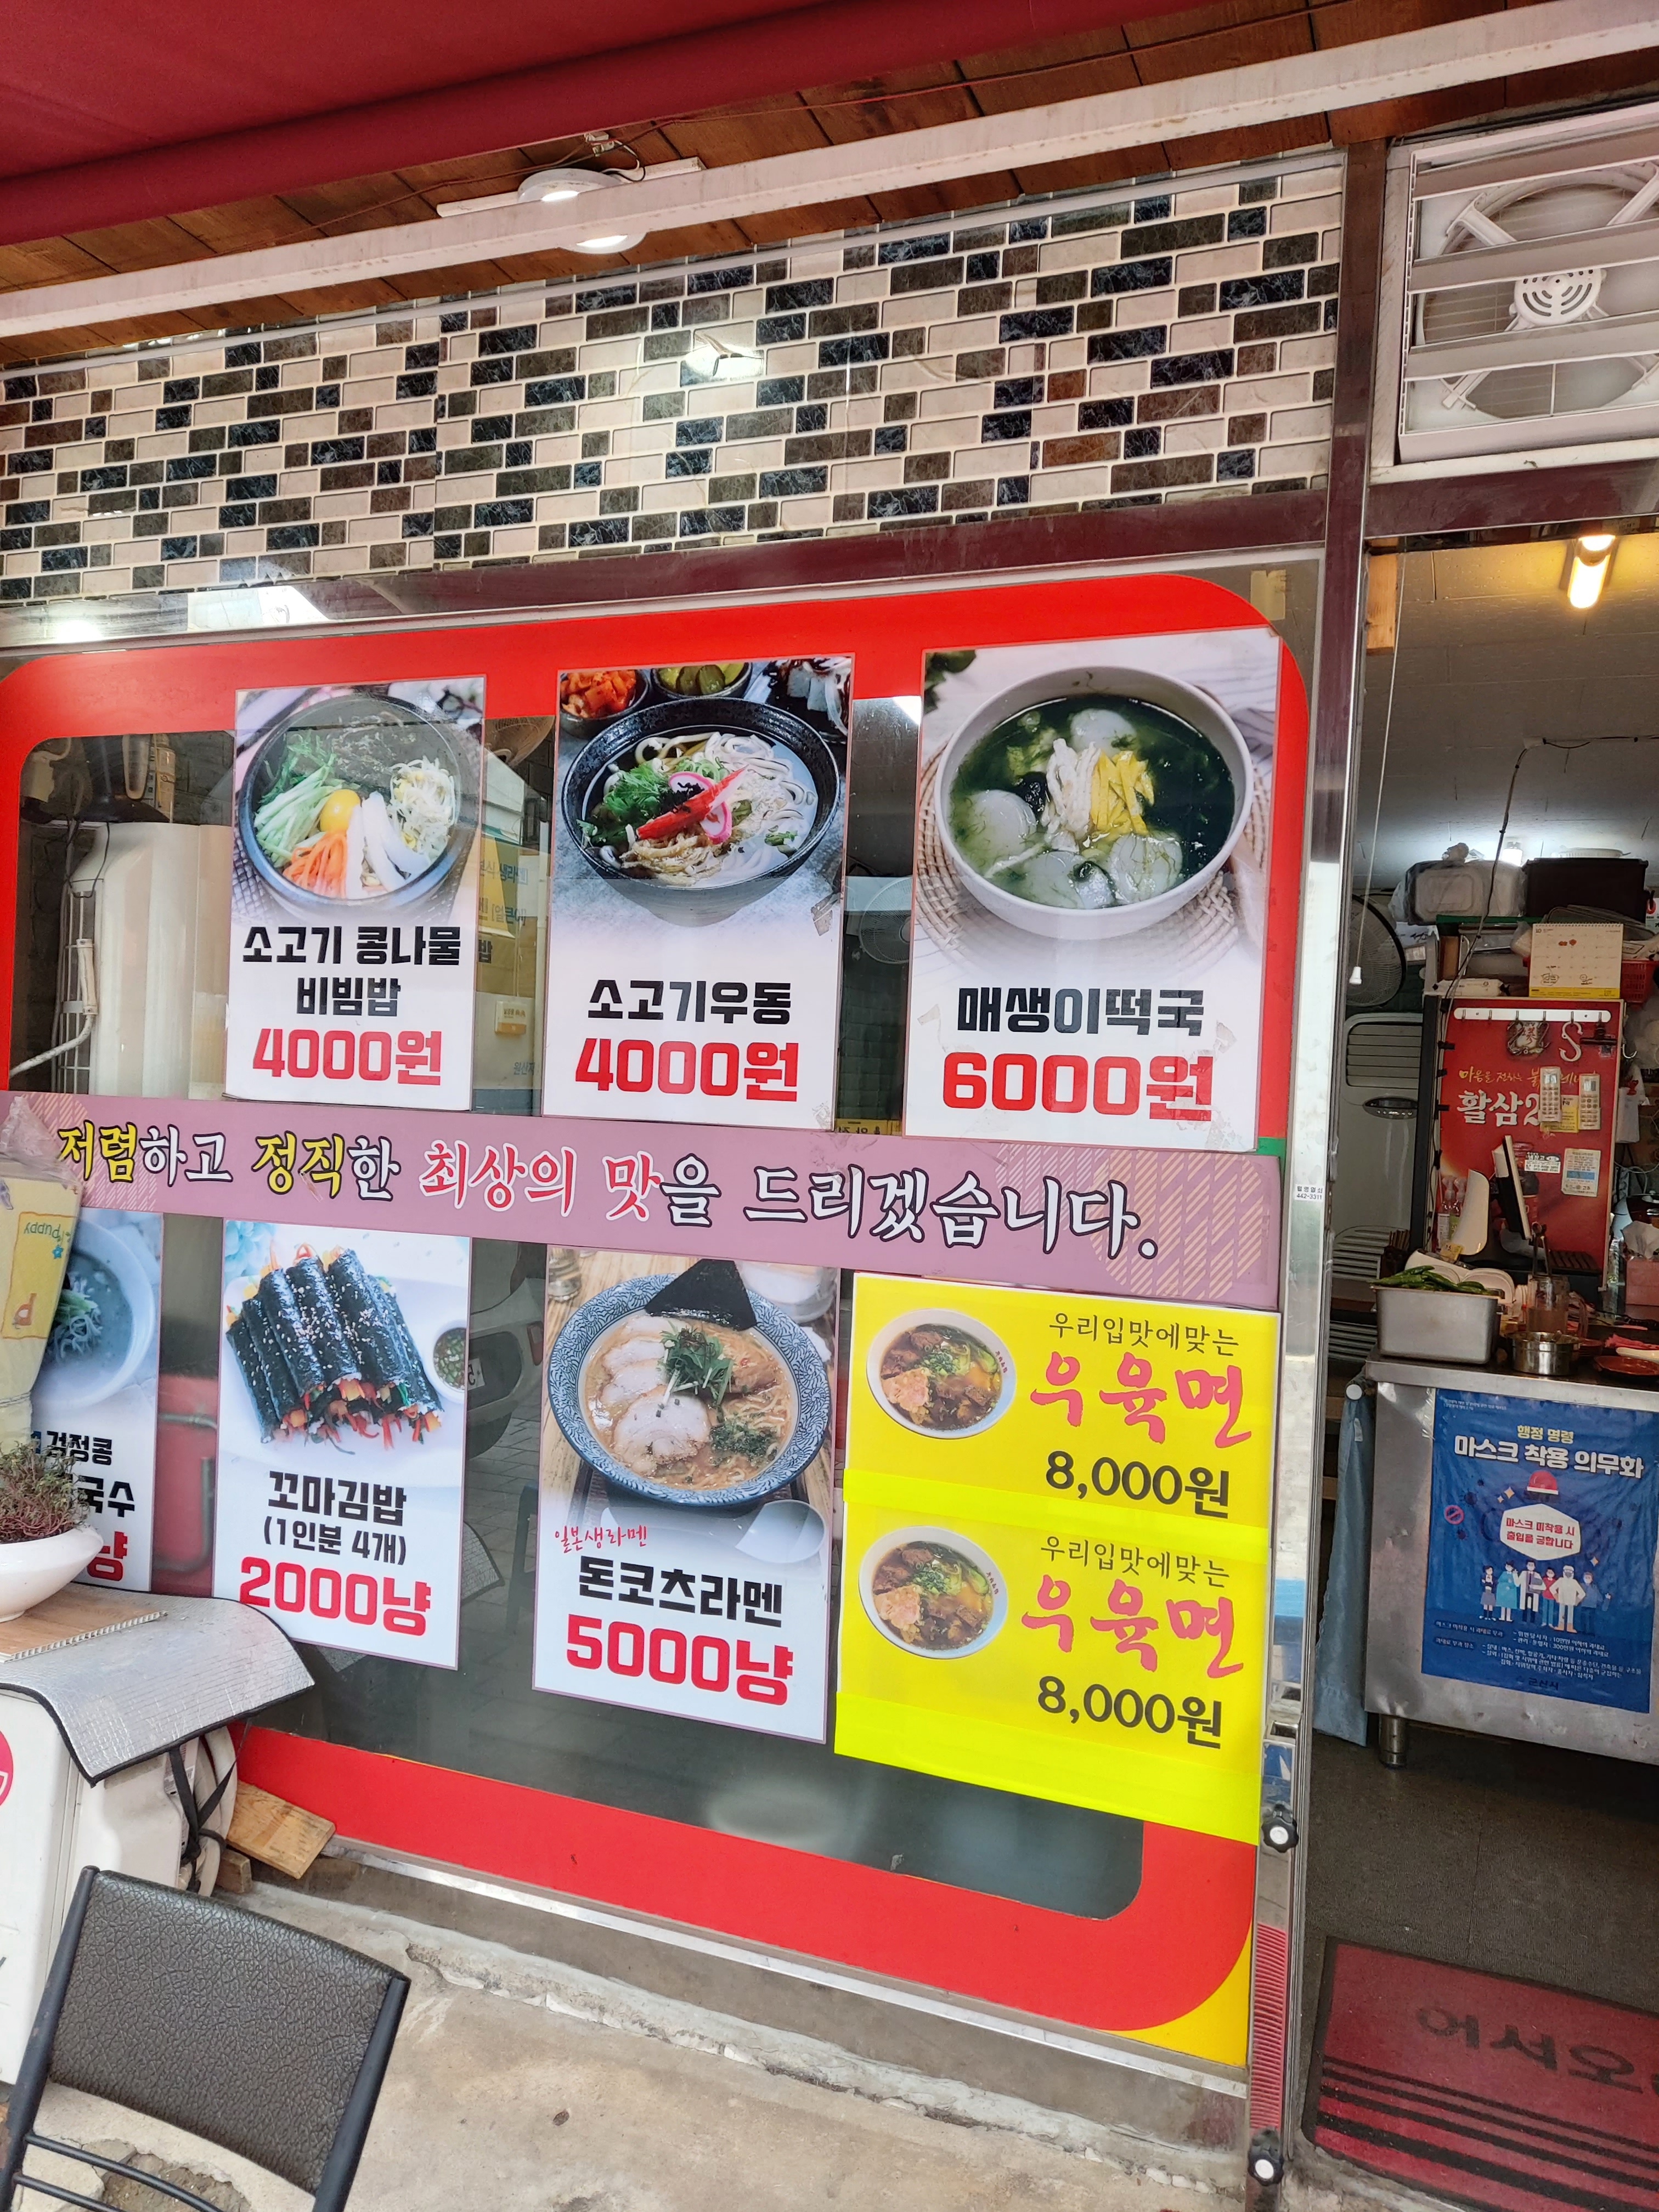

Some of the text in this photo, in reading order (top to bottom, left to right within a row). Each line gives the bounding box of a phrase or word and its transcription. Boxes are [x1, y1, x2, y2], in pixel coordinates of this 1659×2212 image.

[242, 926, 461, 966] 소고기 콩나물
[296, 977, 401, 1017] 비빔밥
[588, 979, 792, 1025] 소고기우동
[957, 987, 1204, 1036] 매생이떡국
[252, 1028, 442, 1086] 4000원
[574, 1037, 799, 1102] 4000원
[943, 1052, 1214, 1121] 6000원
[56, 1119, 1160, 1260] 저렴하고 정직한 최상의 맛을 드리겠습니다.
[1048, 1312, 1240, 1357] 우리입맛에맞는
[1030, 1351, 1251, 1448] 우육면
[46, 1431, 112, 1466] 검정콩
[1454, 1435, 1644, 1479] 마스크 착용 의무화
[1517, 1425, 1574, 1444] 행정 명령
[268, 1470, 408, 1527] 꼬마김밥
[1045, 1450, 1231, 1519] 8,000원
[263, 1516, 407, 1565] (1인분 4개)
[554, 1525, 648, 1554] 일본생라멘
[1506, 1517, 1575, 1536] 마스크 미착용 시
[1506, 1531, 1573, 1549] 출입을 금합니다
[1040, 1534, 1231, 1589] 우리입맛에맞는
[239, 1556, 432, 1637] 2000냥
[579, 1555, 783, 1628] 돈코츠라멘
[1020, 1573, 1244, 1679] 우육면
[566, 1613, 794, 1706] 5000냥
[1037, 1675, 1223, 1750] 8,000원
[1416, 2004, 1659, 2097] 어서오
